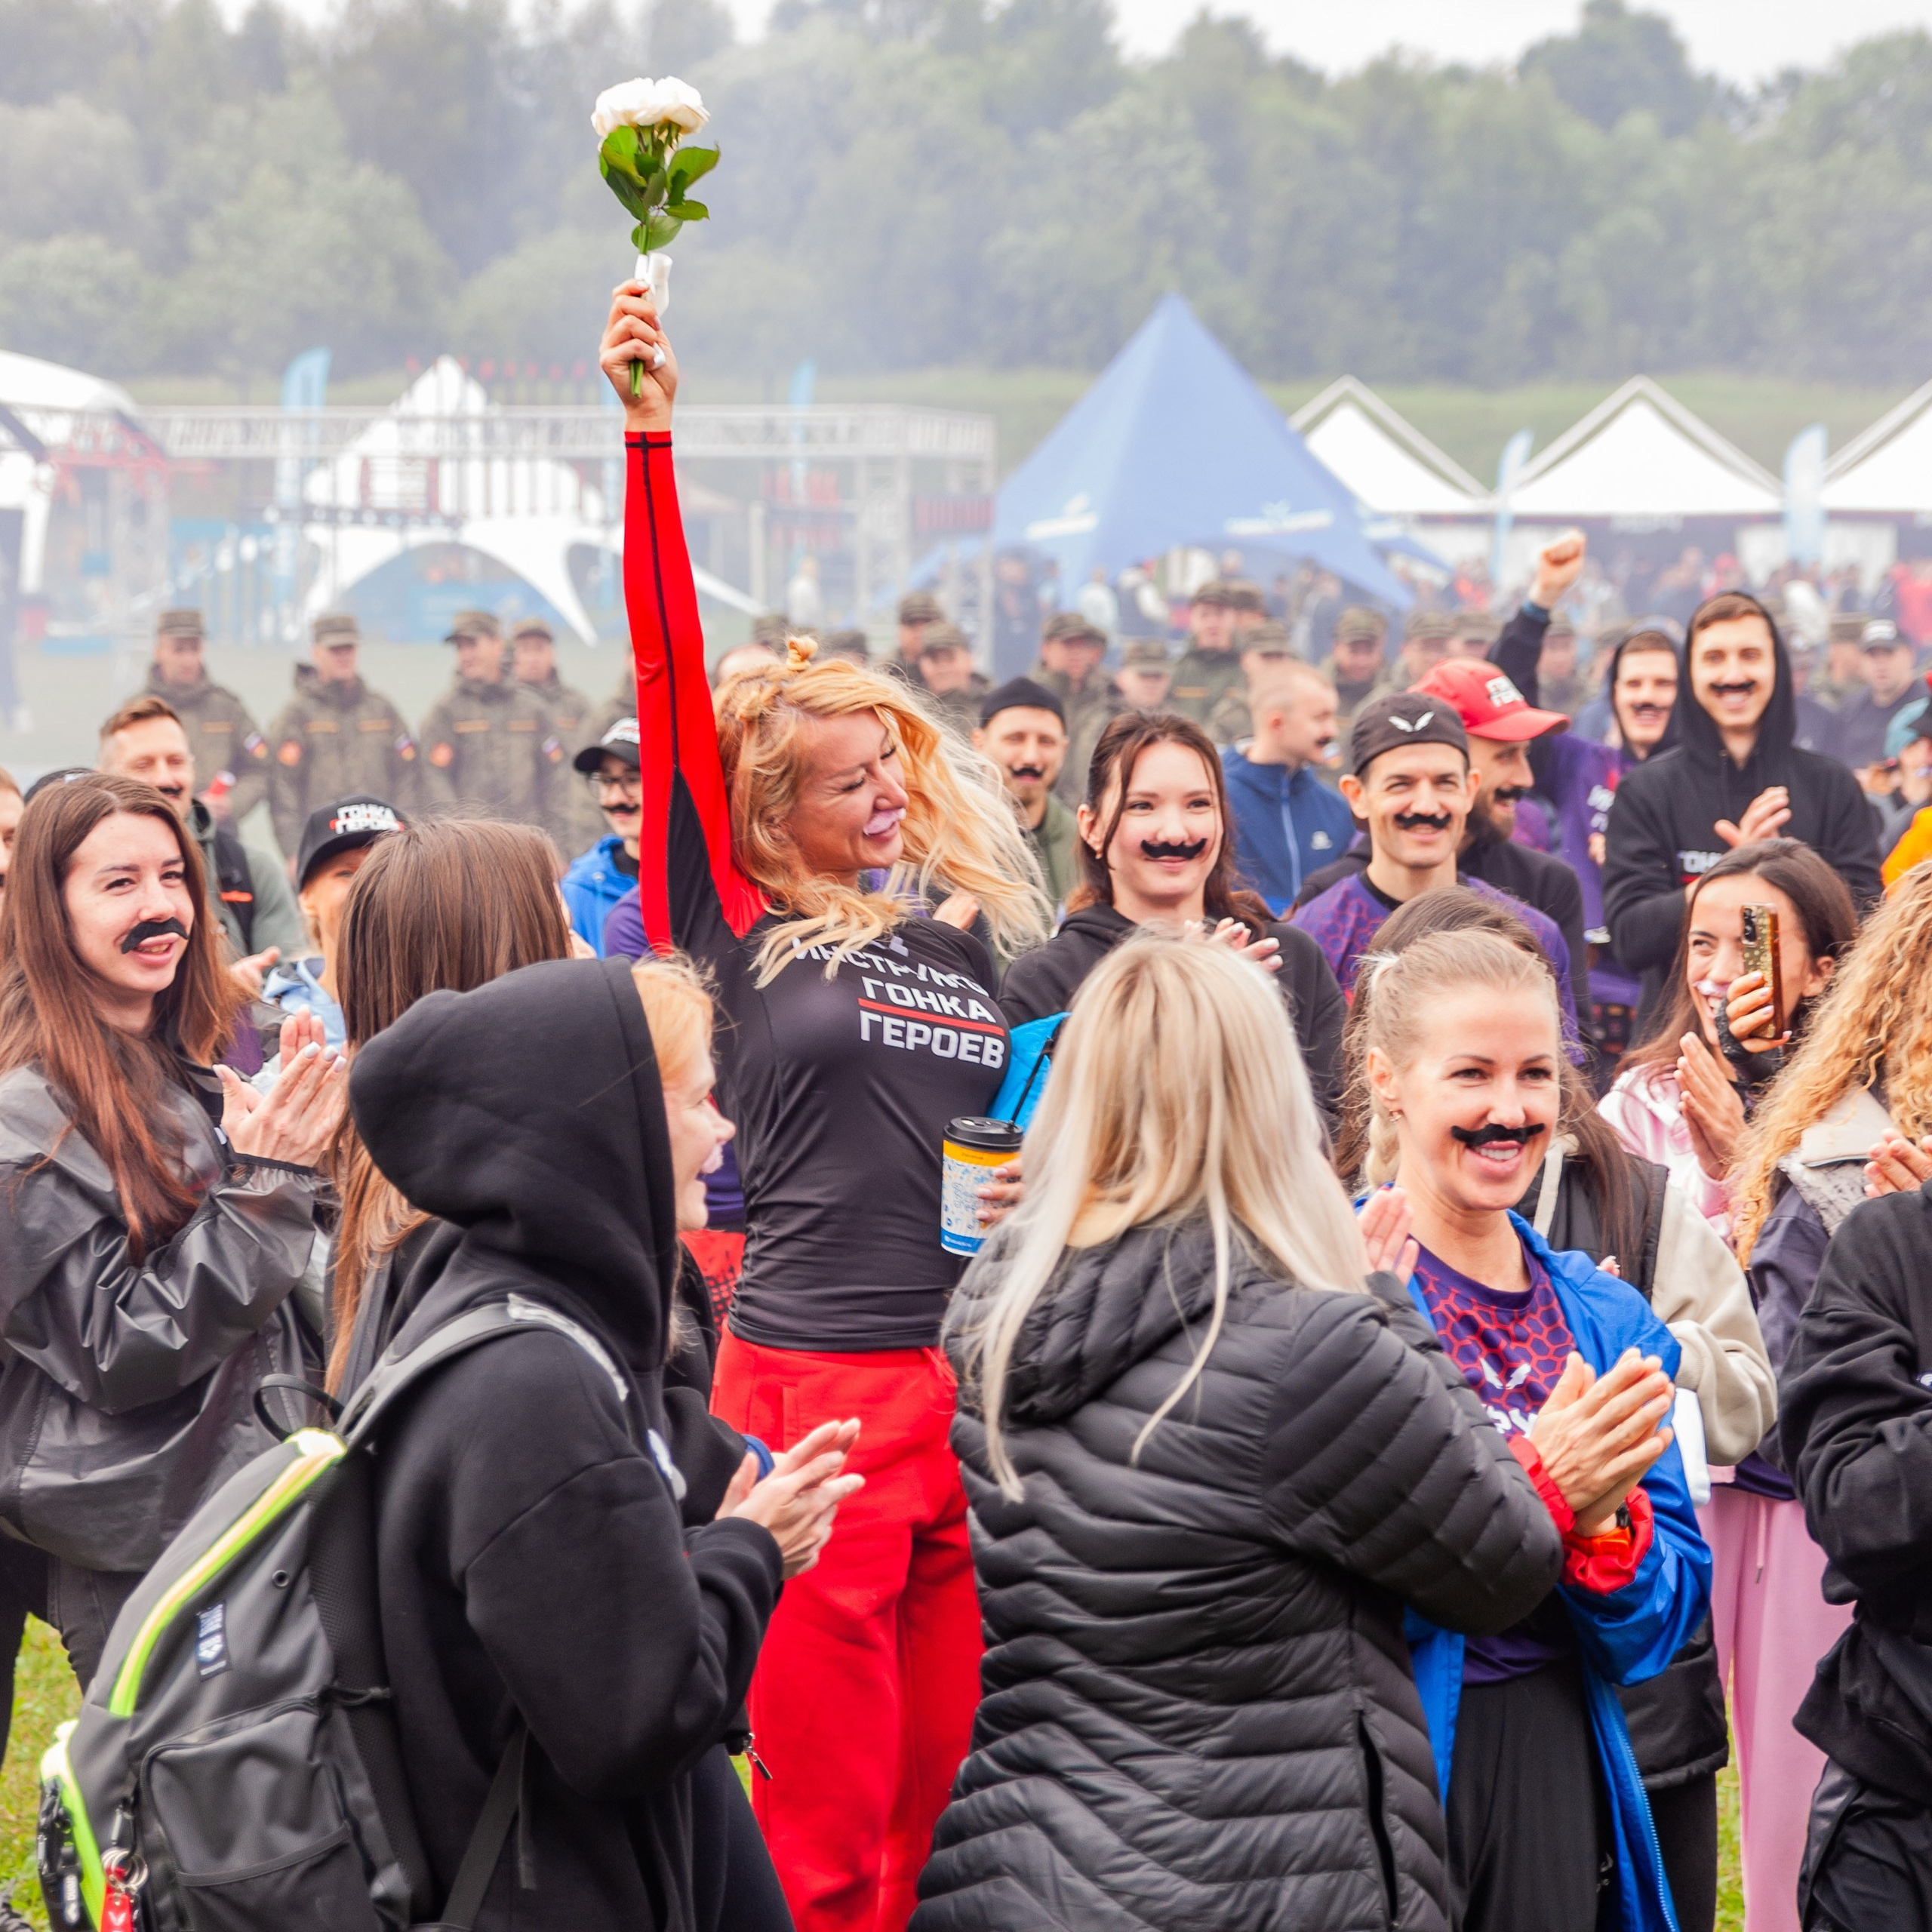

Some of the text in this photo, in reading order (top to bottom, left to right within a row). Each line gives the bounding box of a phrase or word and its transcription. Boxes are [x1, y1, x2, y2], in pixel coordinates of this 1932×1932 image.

[337, 804, 396, 822] ГОНКА
[1677, 850, 1724, 873] ГОН
[861, 976, 997, 1023] ГОНКА
[859, 1010, 1005, 1069] ГЕРОЕВ
